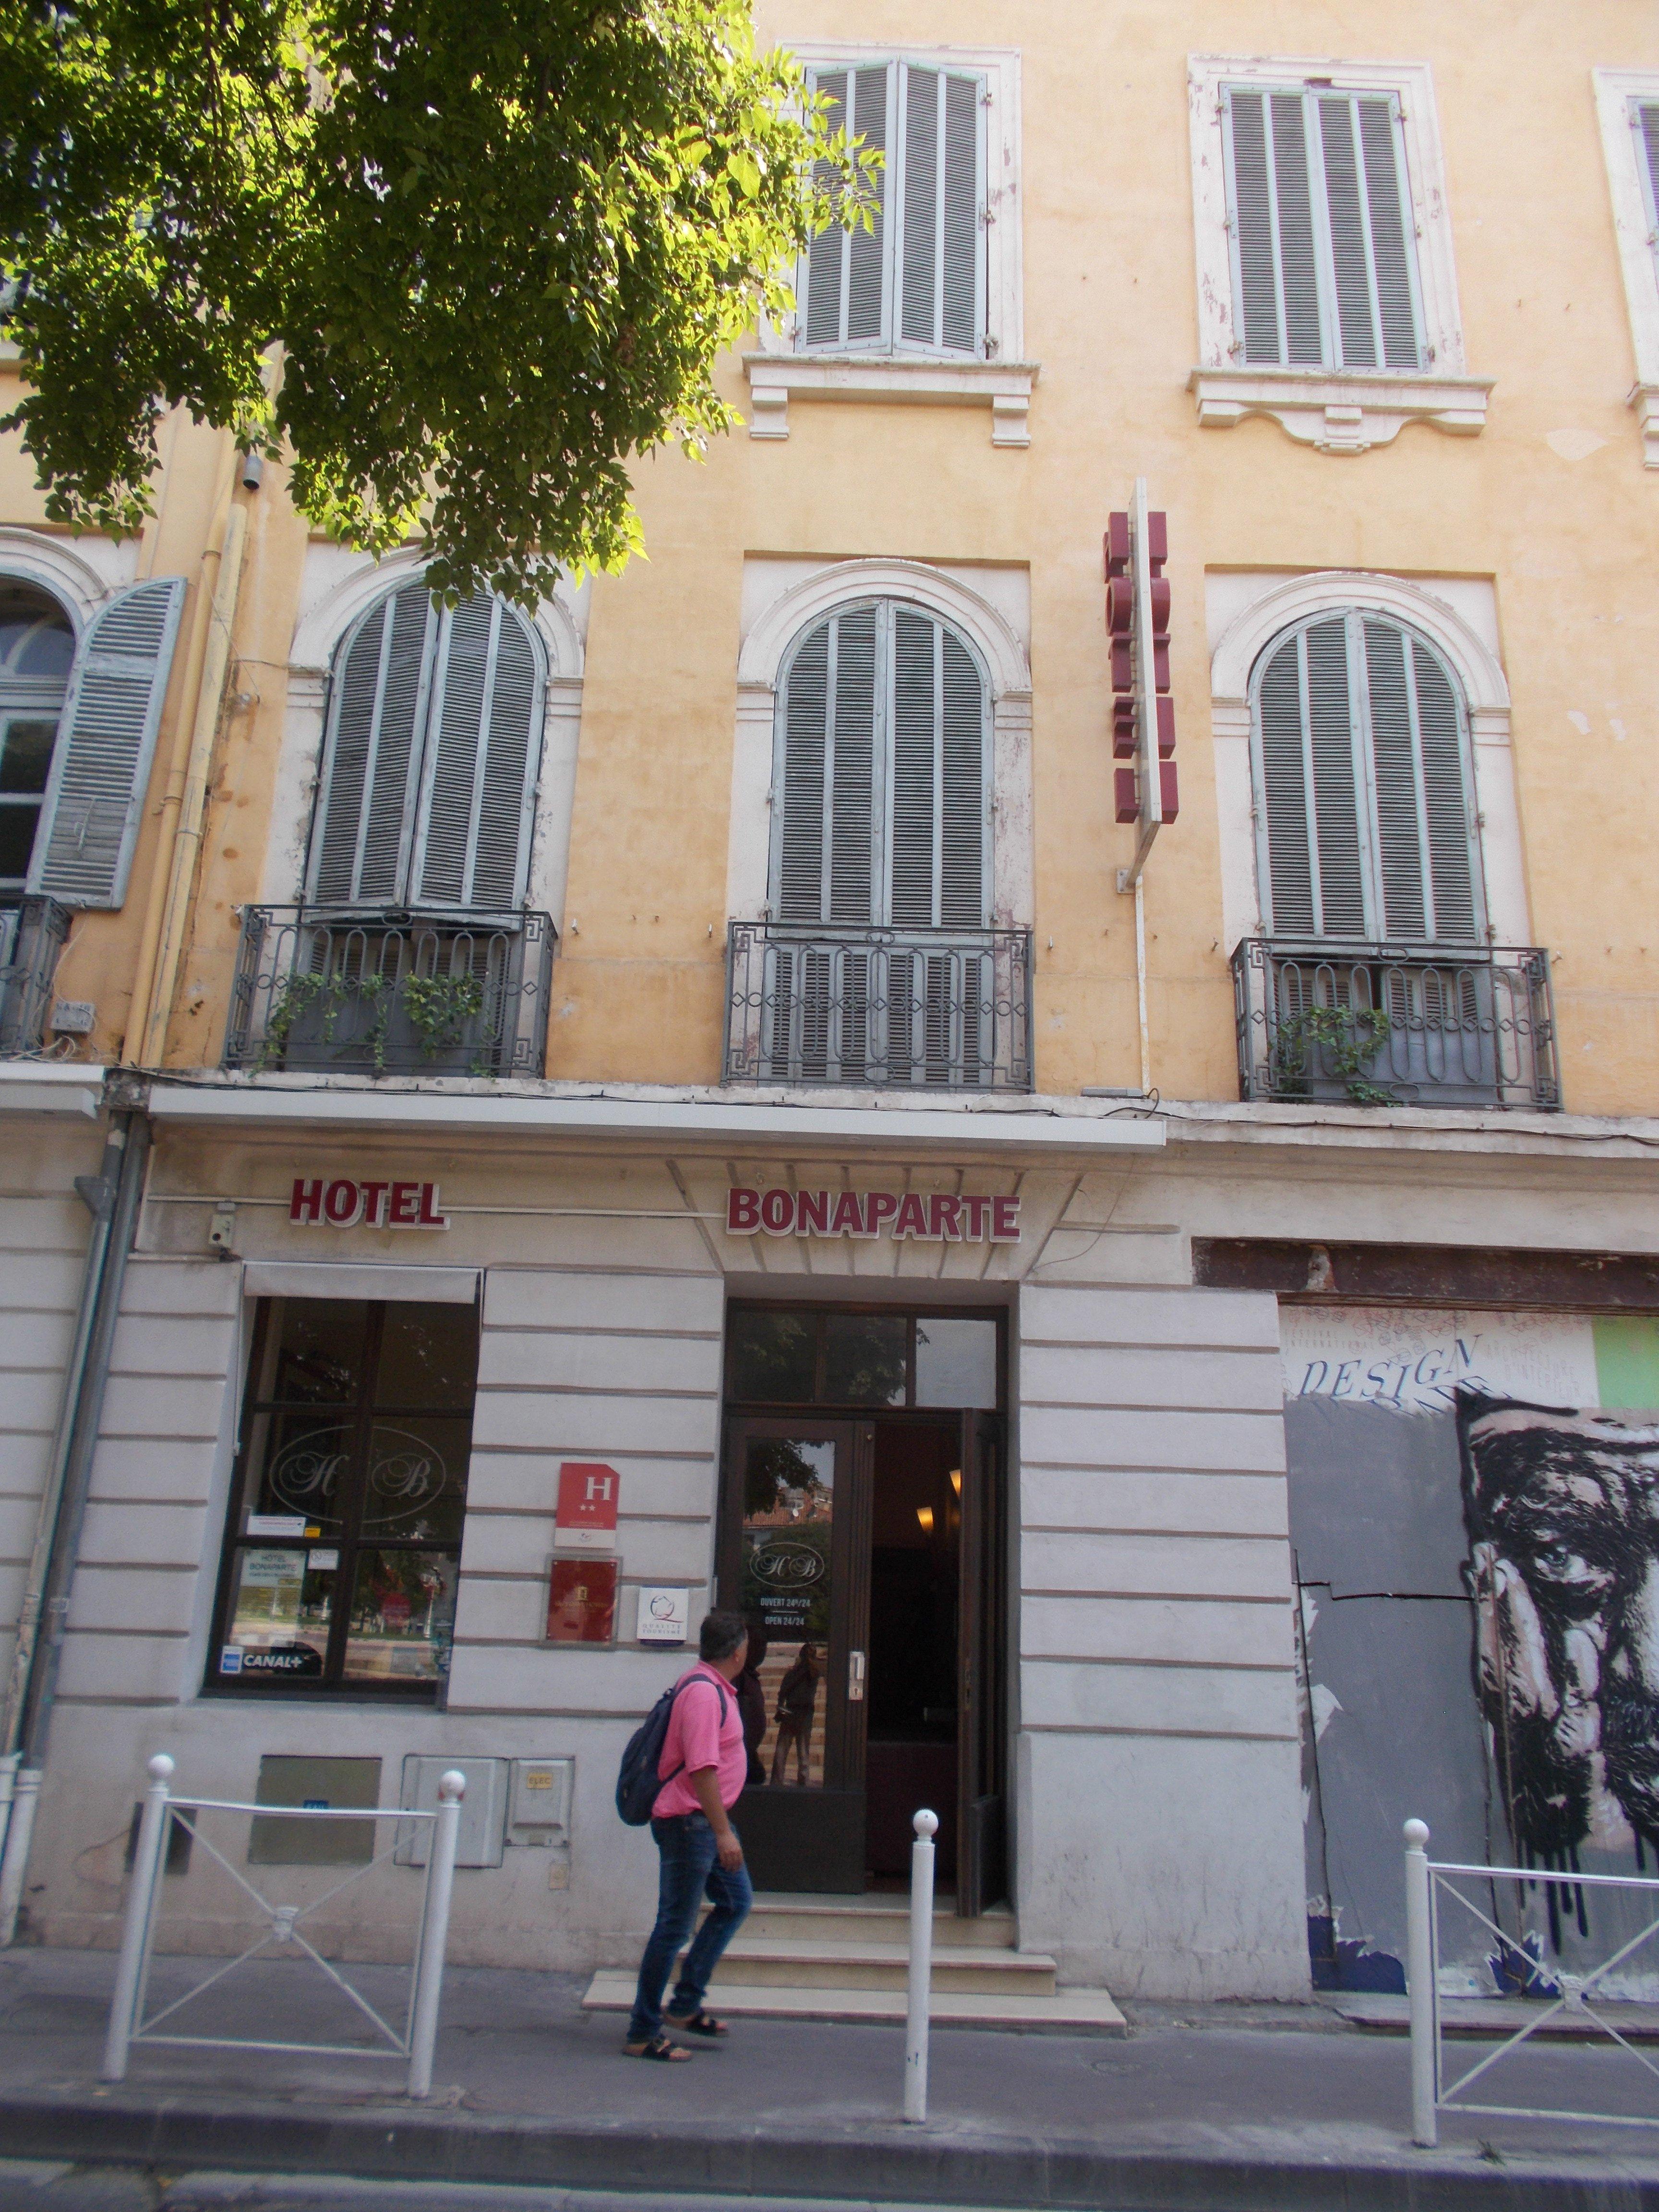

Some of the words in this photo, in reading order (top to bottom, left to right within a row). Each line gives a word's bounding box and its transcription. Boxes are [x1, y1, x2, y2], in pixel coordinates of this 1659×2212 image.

[289, 1178, 450, 1230] HOTEL
[727, 1188, 1021, 1243] BONAPARTE
[1298, 1333, 1483, 1398] DESIGN
[585, 1477, 613, 1501] H
[760, 1598, 785, 1607] OUVERT
[765, 1616, 782, 1625] OPEN
[783, 1617, 805, 1625] 24/24
[243, 1654, 303, 1668] CANAL+
